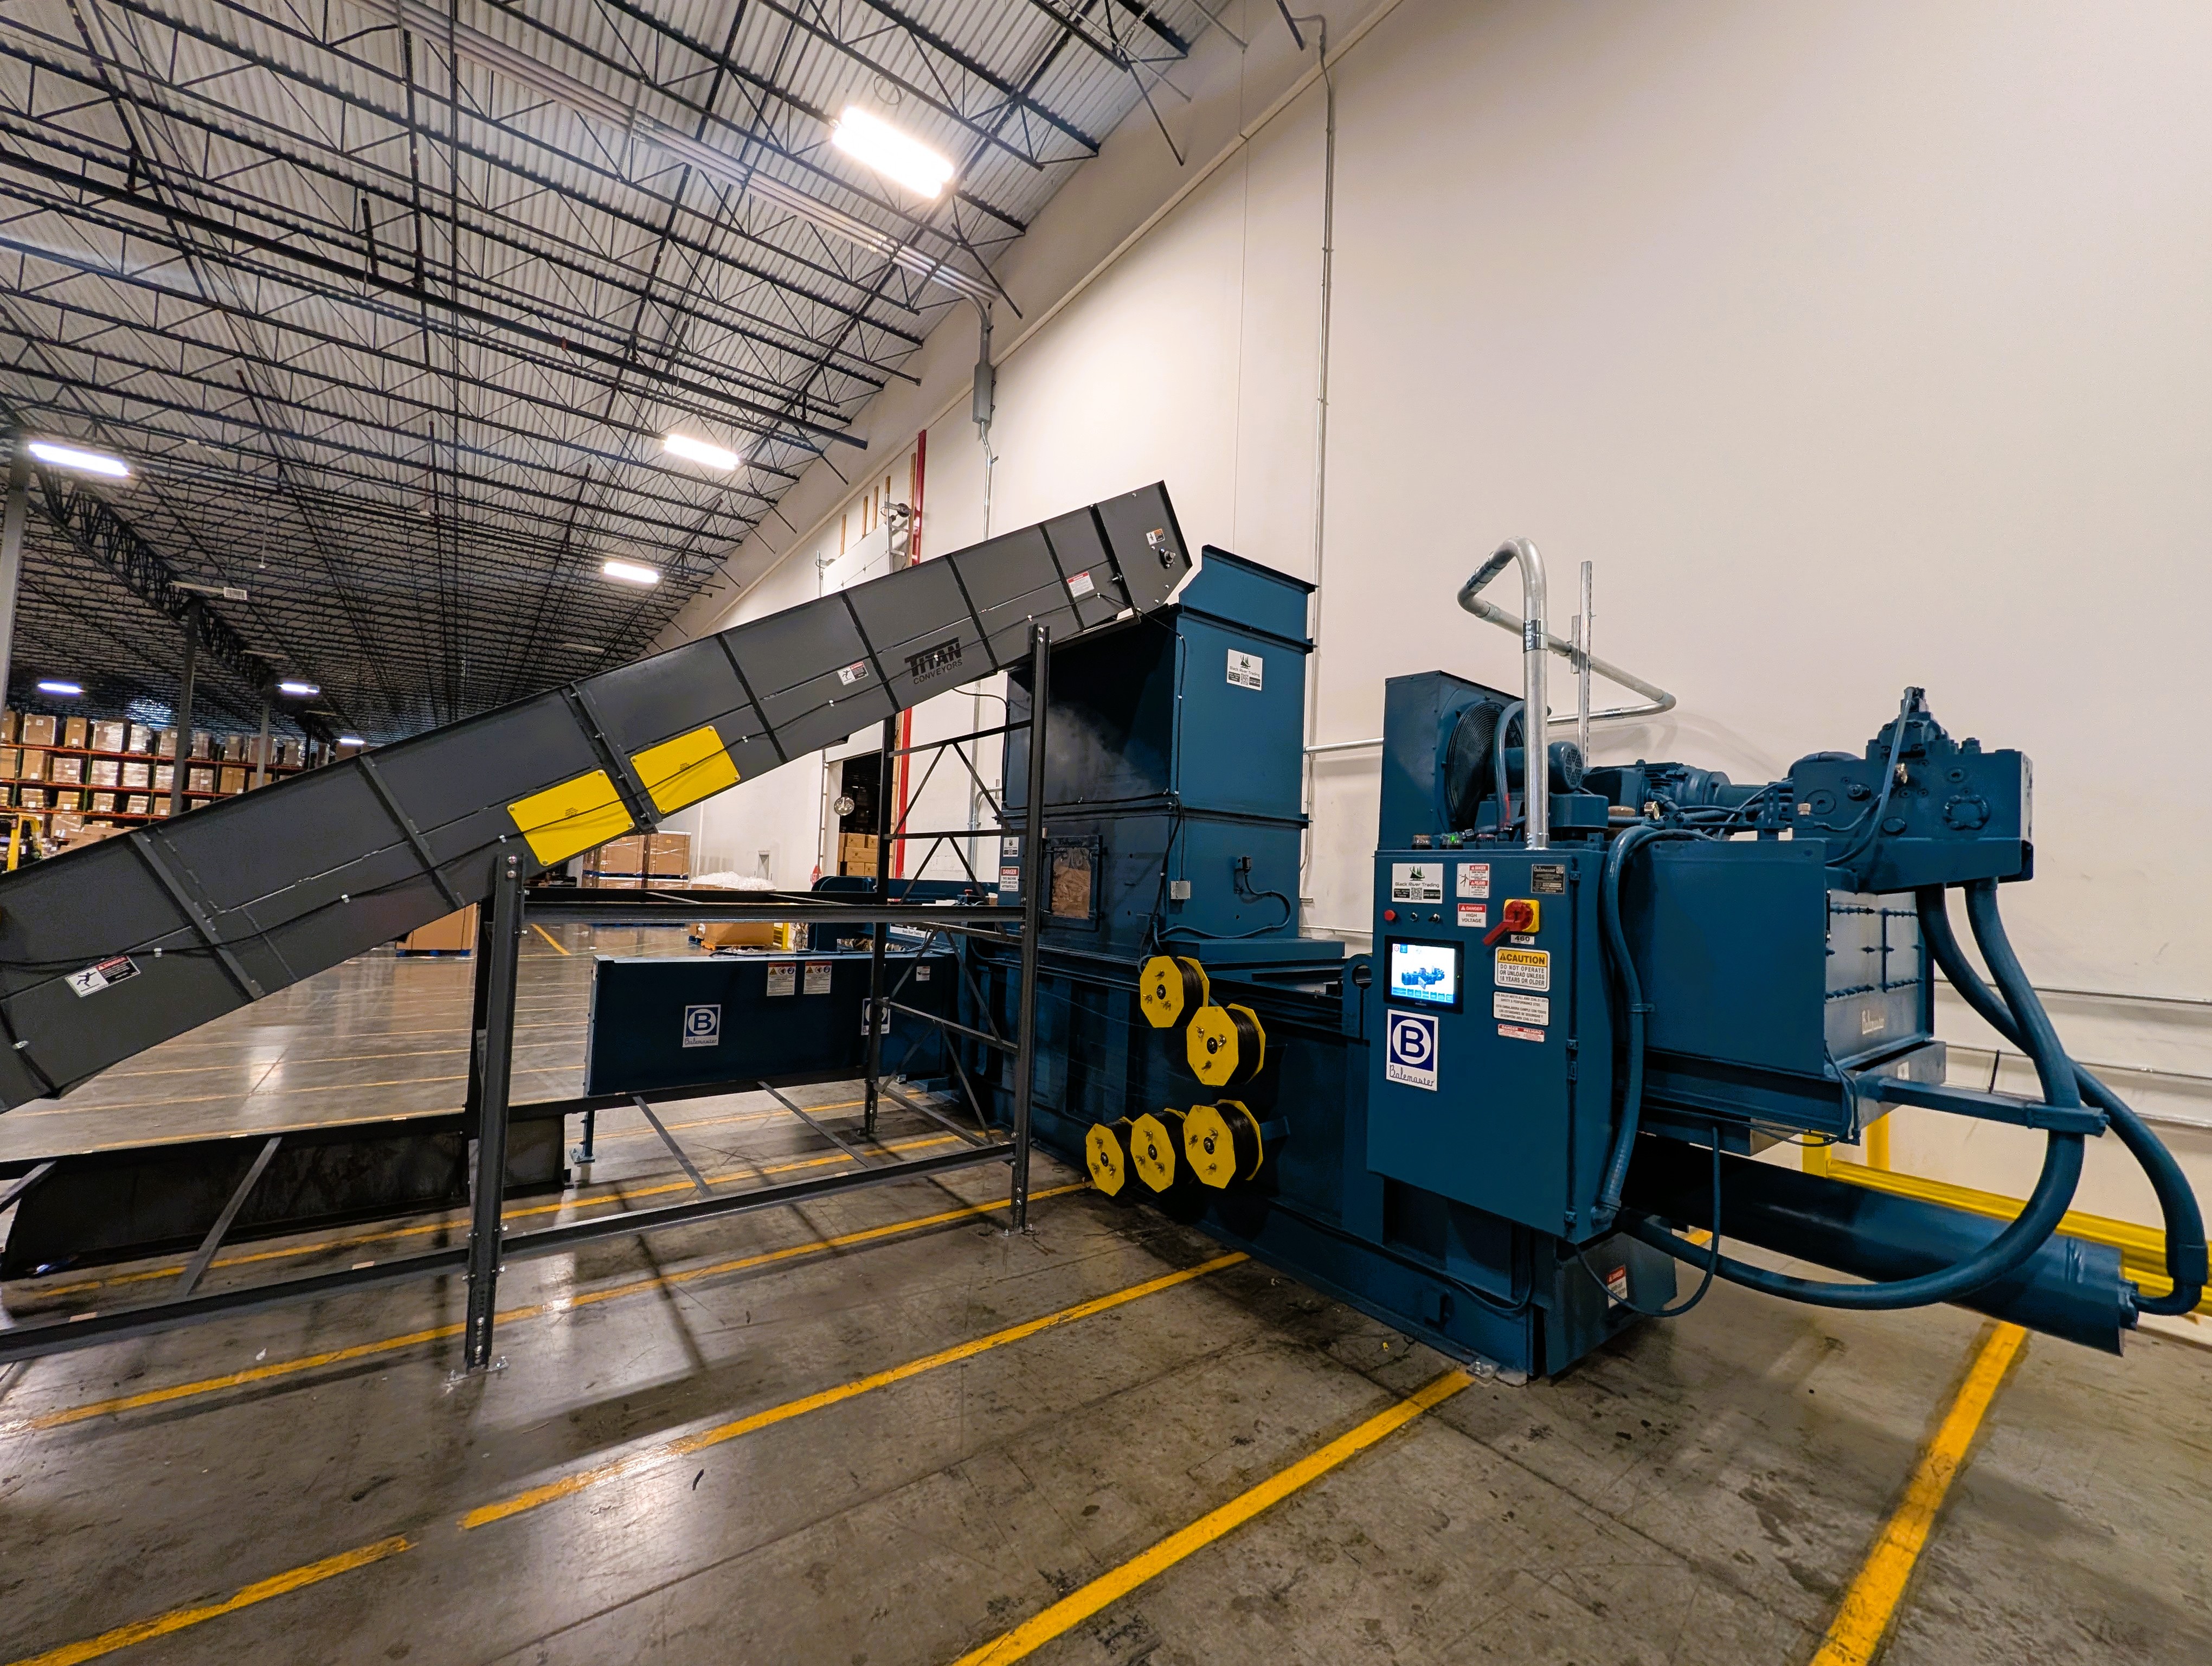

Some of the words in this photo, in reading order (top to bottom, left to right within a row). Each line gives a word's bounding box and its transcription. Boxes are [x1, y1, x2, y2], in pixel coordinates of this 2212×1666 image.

[904, 637, 962, 677] TITAN
[914, 659, 962, 684] CONVEYORS
[1506, 954, 1545, 964] CAUTION
[693, 1013, 712, 1031] B
[1400, 1025, 1425, 1058] B
[1390, 1065, 1434, 1087] Balemaster
